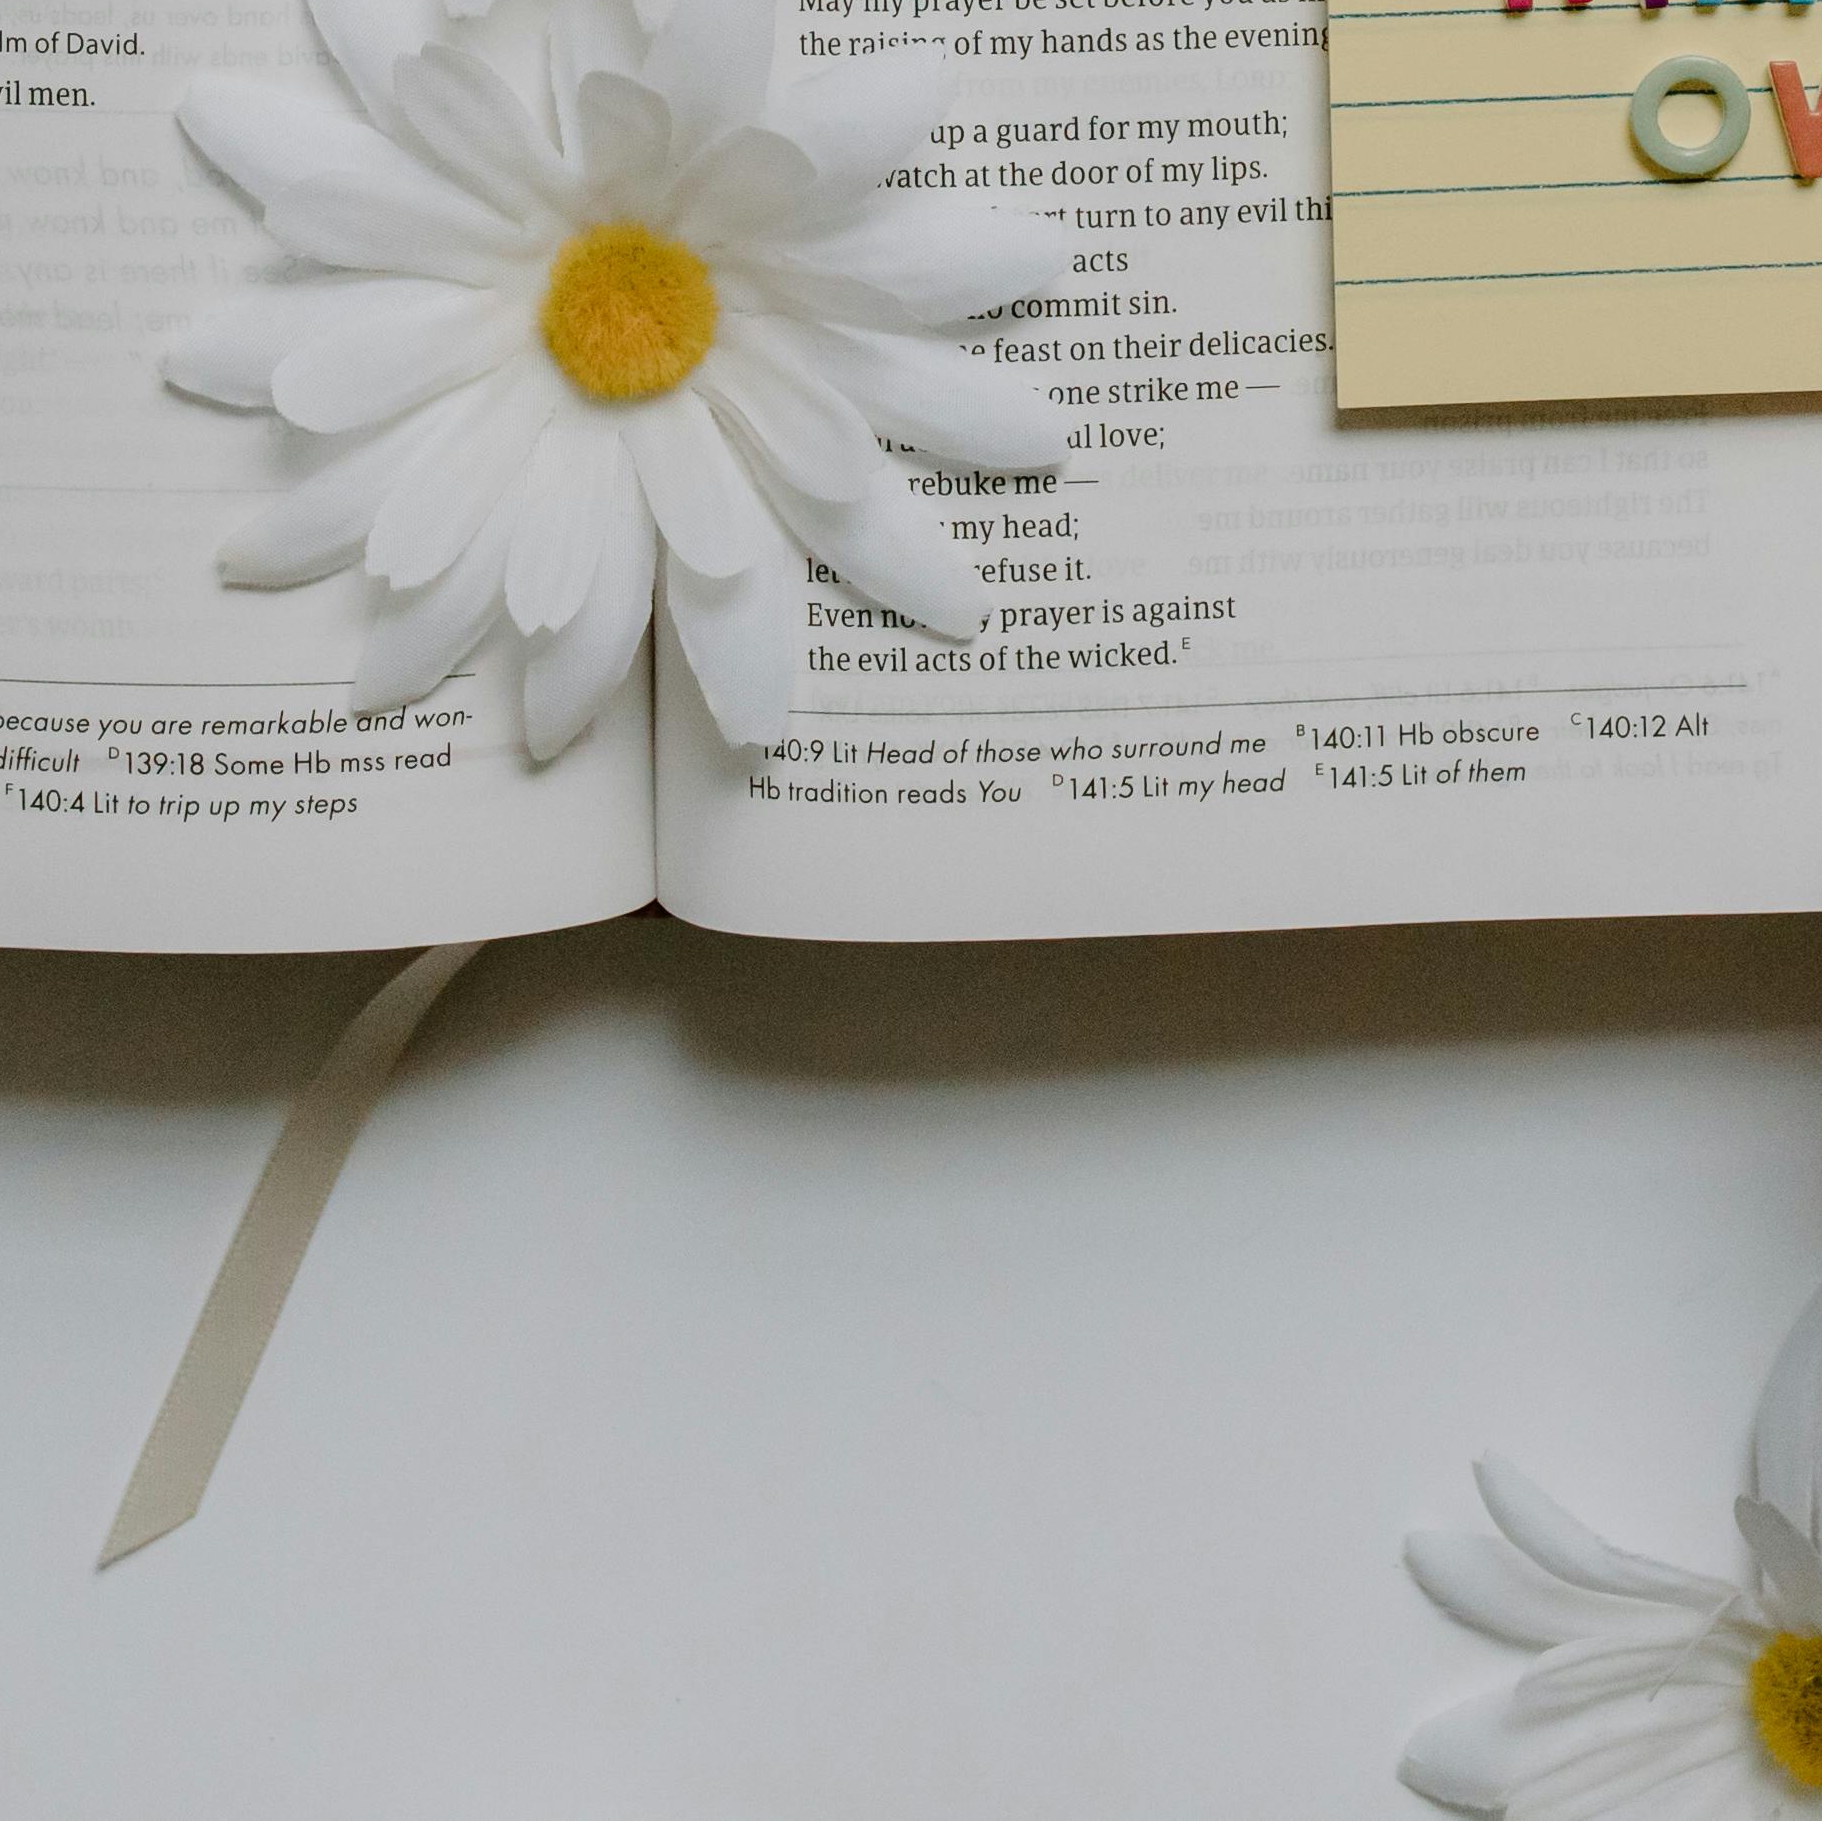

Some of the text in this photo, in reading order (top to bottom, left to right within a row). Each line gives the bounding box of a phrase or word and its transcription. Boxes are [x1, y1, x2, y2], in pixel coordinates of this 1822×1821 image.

[33, 29, 62, 55] of
[65, 31, 146, 57] David.
[97, 715, 144, 742] you
[150, 715, 193, 737] are
[200, 708, 348, 737] remarkable
[355, 705, 408, 733] and
[832, 739, 859, 765] Lit
[865, 738, 937, 766] Head
[941, 737, 971, 765] of
[975, 737, 1043, 764] those
[1049, 734, 1104, 763] who
[1110, 728, 1224, 761] surround
[1229, 737, 1268, 755] me
[1397, 720, 1436, 748] Hb
[1441, 721, 1541, 746] obscure
[1673, 710, 1711, 738] Alt
[746, 775, 782, 801] Hb
[787, 777, 889, 805] tradition
[896, 777, 968, 806] reads
[977, 778, 1023, 804] You
[1142, 773, 1170, 799] Lit
[1177, 778, 1216, 804] my
[1221, 766, 1288, 796] head
[1401, 762, 1429, 787] Lit
[1434, 757, 1464, 786] of
[1467, 756, 1527, 784] them
[93, 789, 121, 815] Lit
[127, 793, 152, 816] to
[158, 793, 201, 824] trip
[208, 799, 241, 824] up
[248, 798, 288, 824] my
[293, 793, 359, 822] steps
